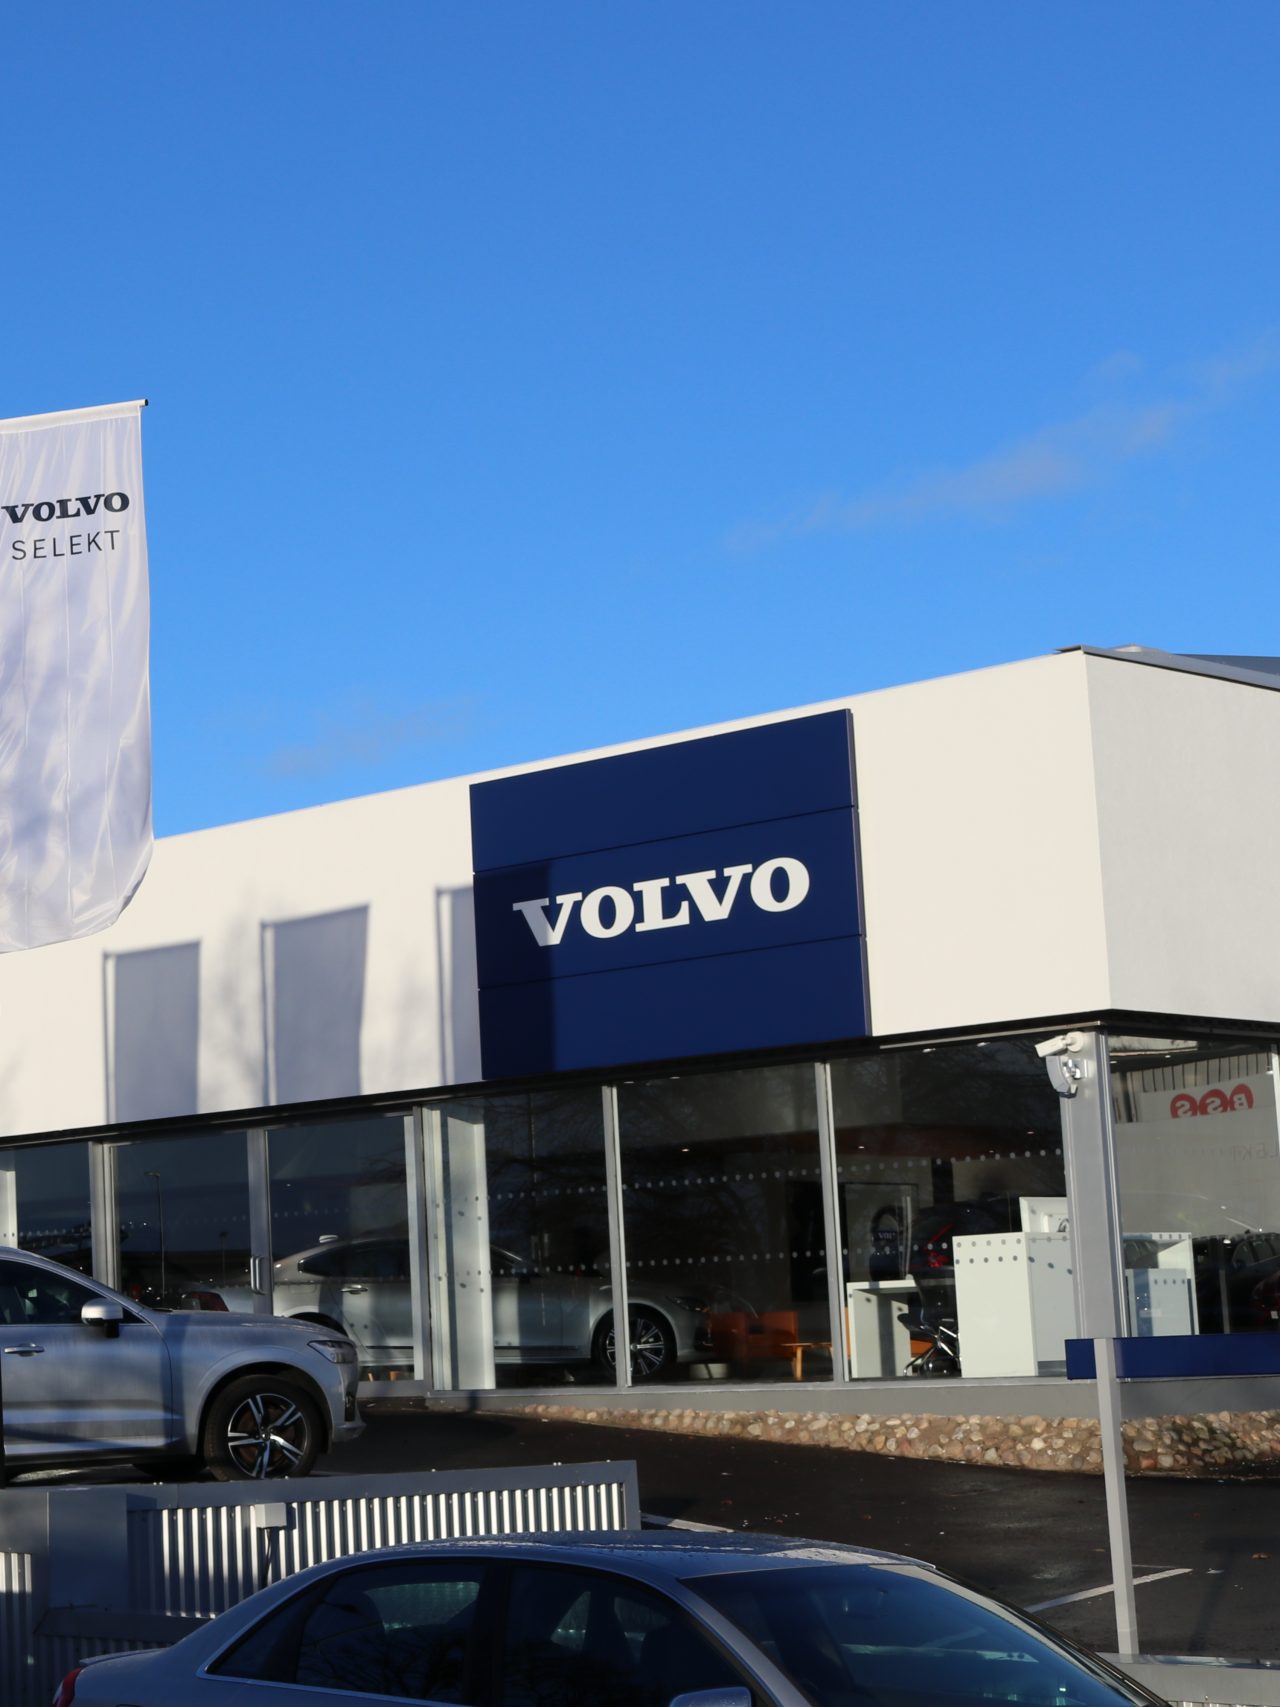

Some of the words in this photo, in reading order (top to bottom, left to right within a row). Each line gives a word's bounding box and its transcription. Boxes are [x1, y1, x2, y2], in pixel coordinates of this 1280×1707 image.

[1, 491, 130, 524] VOLVO
[11, 529, 121, 561] SELEKT
[512, 857, 810, 947] VOLVO
